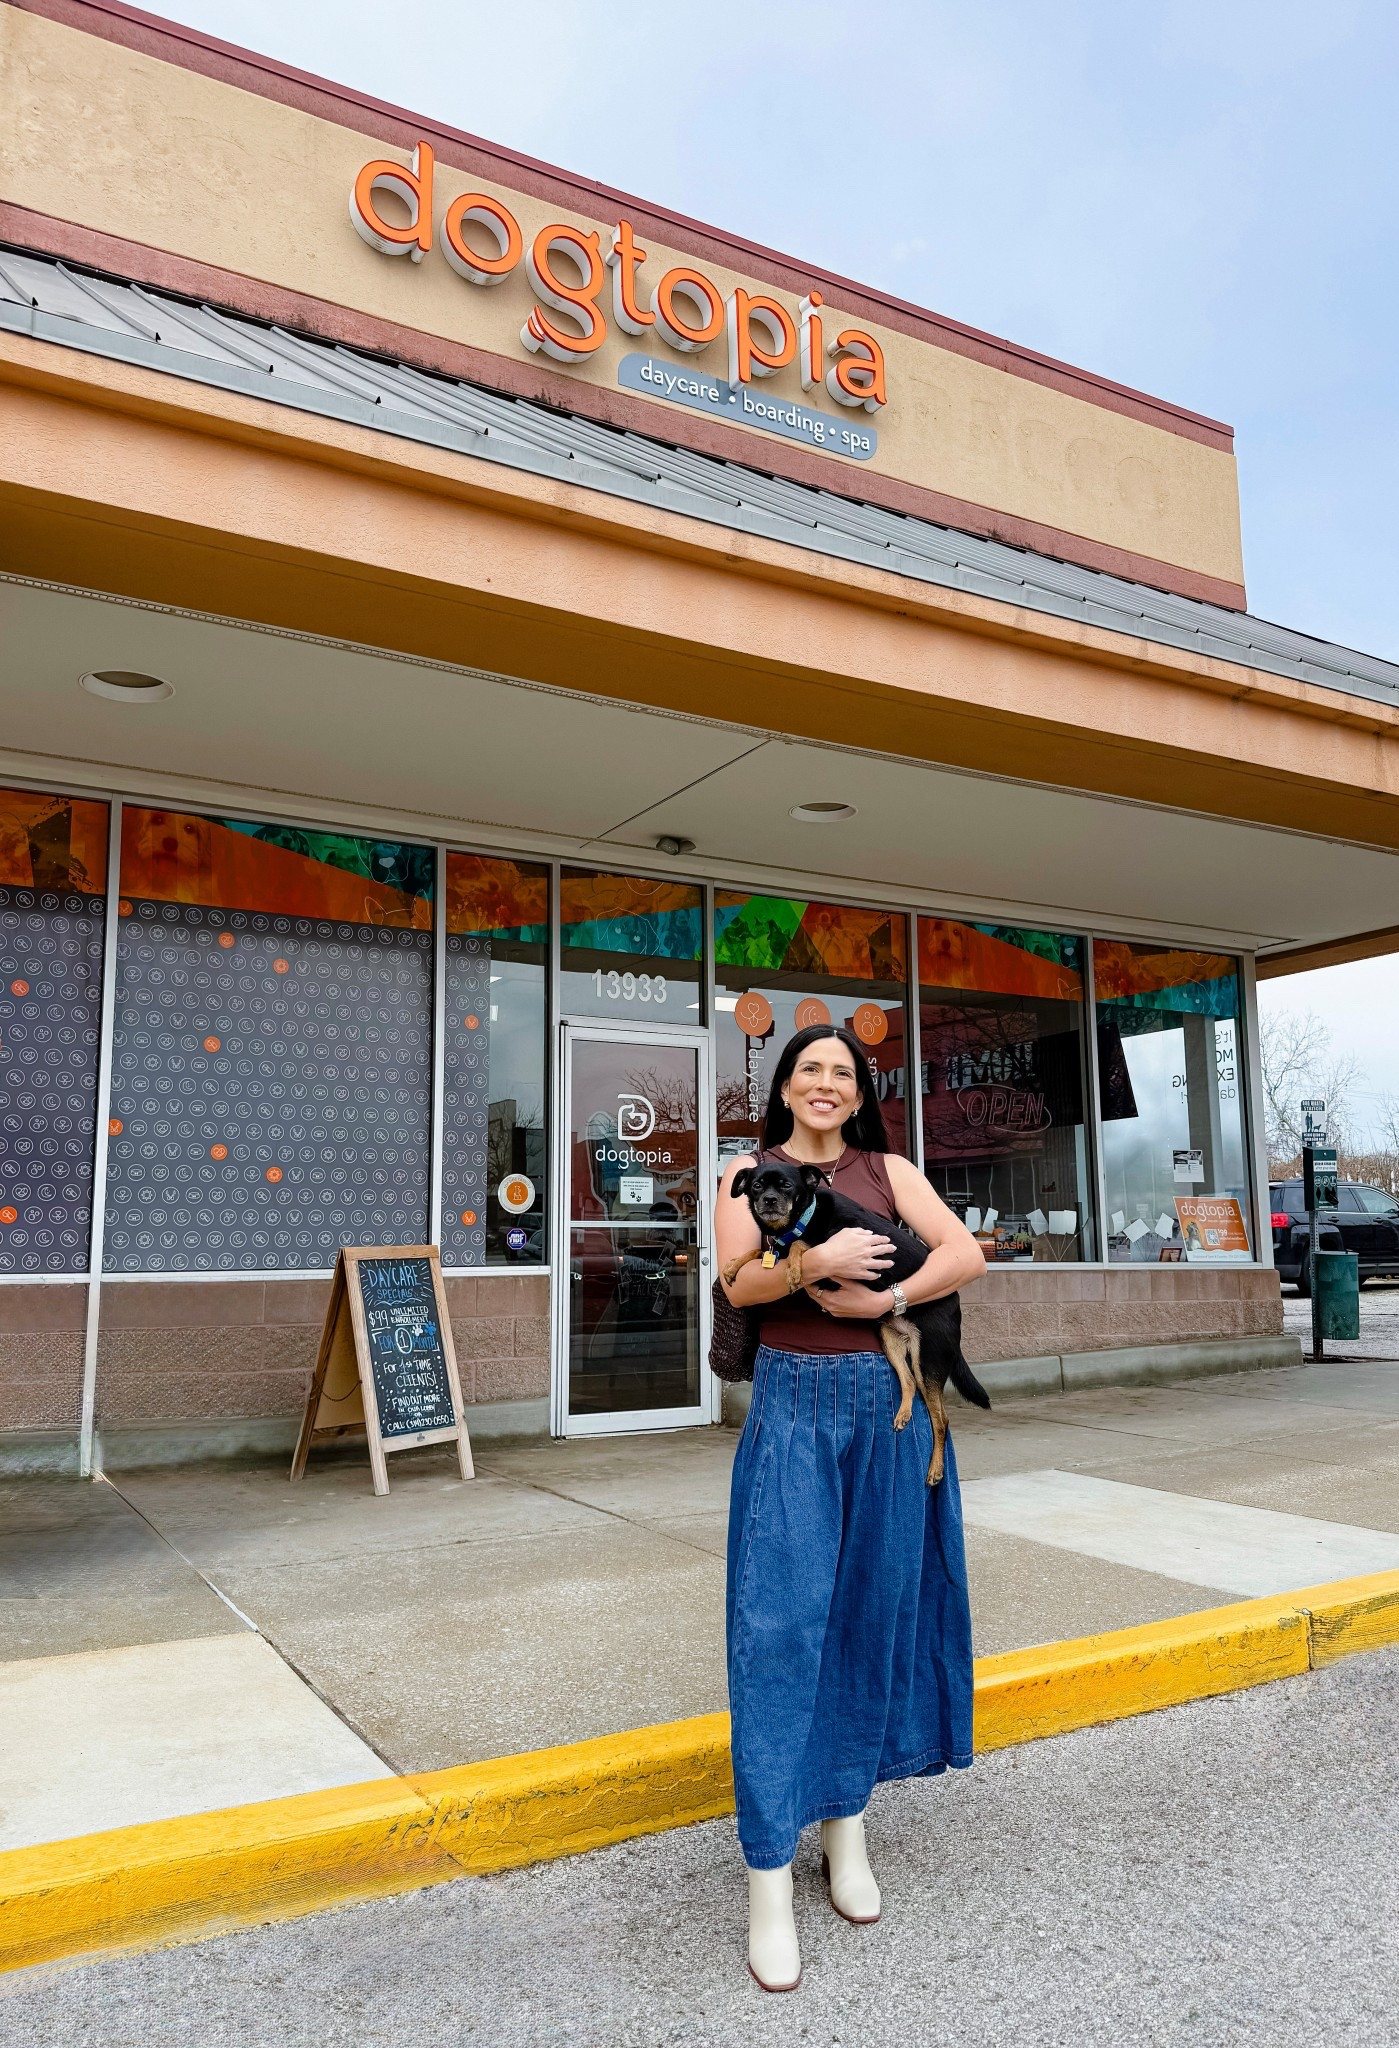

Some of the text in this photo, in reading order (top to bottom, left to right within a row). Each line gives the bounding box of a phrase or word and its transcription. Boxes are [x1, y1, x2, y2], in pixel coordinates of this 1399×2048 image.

[349, 139, 887, 414] dogtopia
[640, 359, 871, 453] daycare boarding spa
[591, 968, 667, 1004] 13933
[742, 1048, 764, 1123] daycare
[966, 1090, 1045, 1127] OPEN
[996, 1241, 1024, 1250] DASH
[367, 1264, 422, 1288] DAYCARE
[368, 1305, 429, 1328] $99 UNLIMITED
[378, 1335, 394, 1352] FOR
[412, 1335, 436, 1350] MONTH
[392, 1395, 410, 1410] FIND
[410, 1394, 422, 1404] OUT
[387, 1420, 405, 1432] CALL
